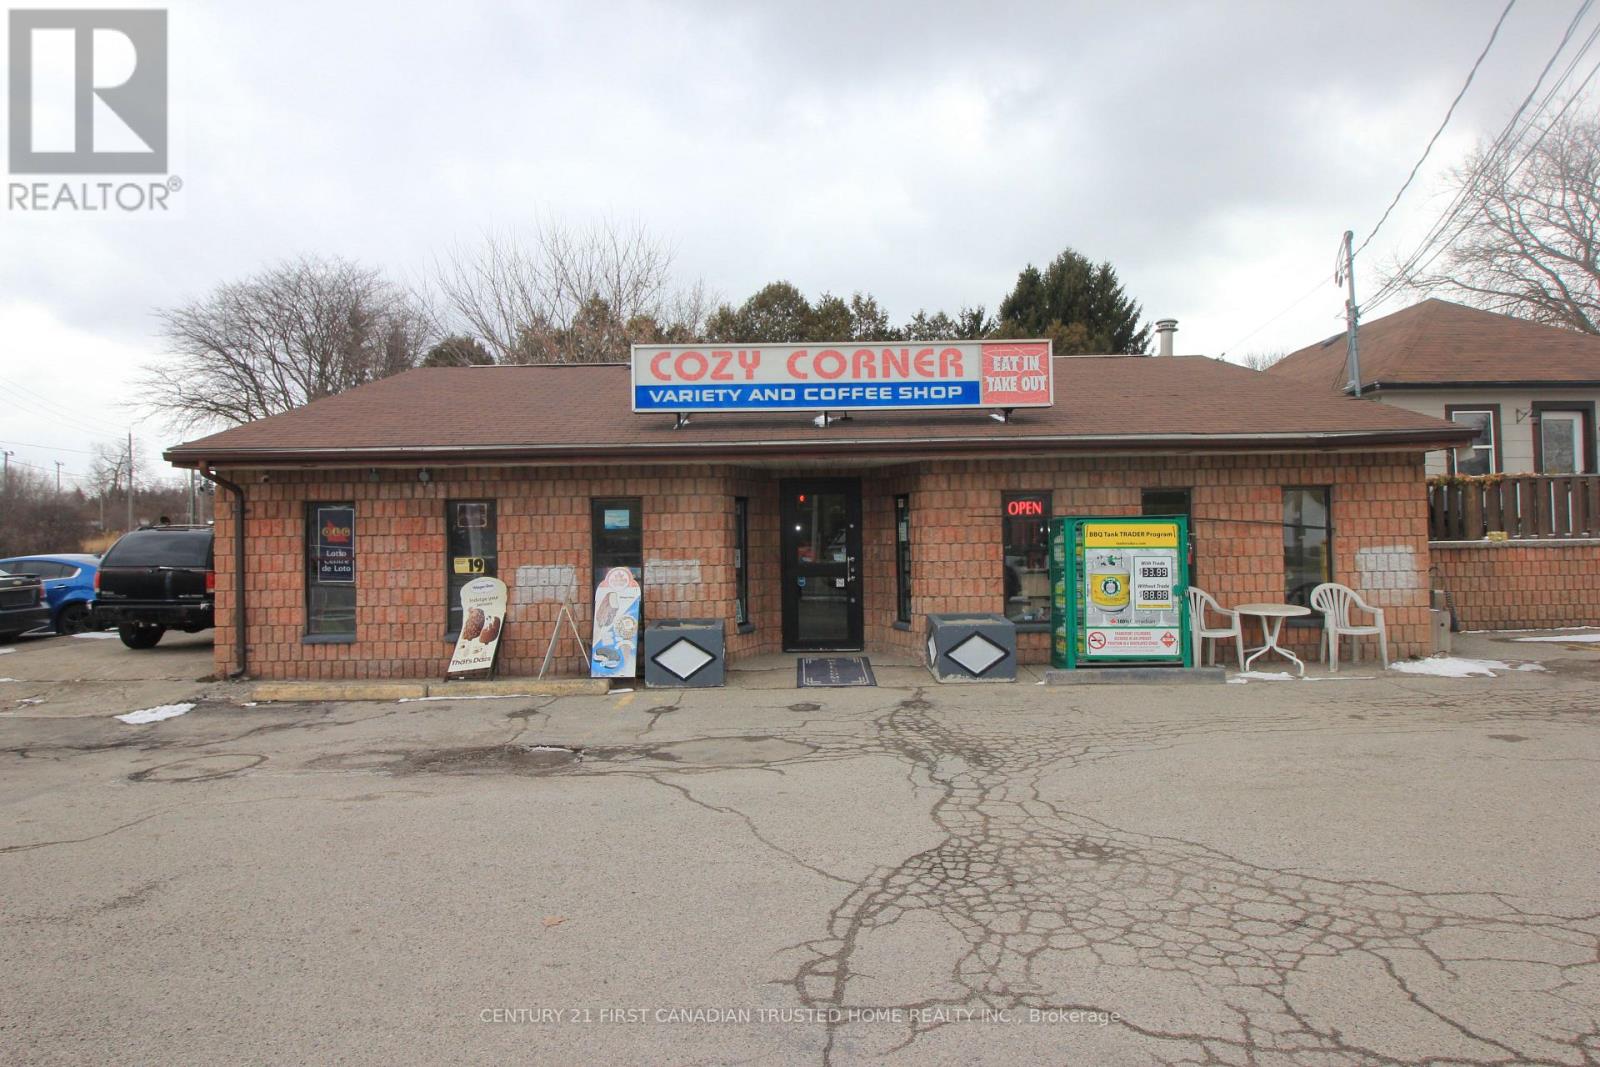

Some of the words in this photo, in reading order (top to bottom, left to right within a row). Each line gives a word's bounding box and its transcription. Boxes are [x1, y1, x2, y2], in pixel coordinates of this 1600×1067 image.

[650, 350, 761, 382] COZY
[786, 347, 964, 380] CORNER
[992, 355, 1018, 372] EAT
[1023, 355, 1041, 371] IN
[983, 375, 1018, 393] TAKE
[1021, 375, 1047, 392] OUT
[649, 388, 743, 403] VARIETY
[748, 387, 796, 402] AND
[803, 386, 893, 401] COFFEE
[898, 385, 963, 401] SHOP
[1007, 501, 1043, 516] OPEN
[1146, 531, 1173, 539] Program
[468, 558, 484, 573] 19
